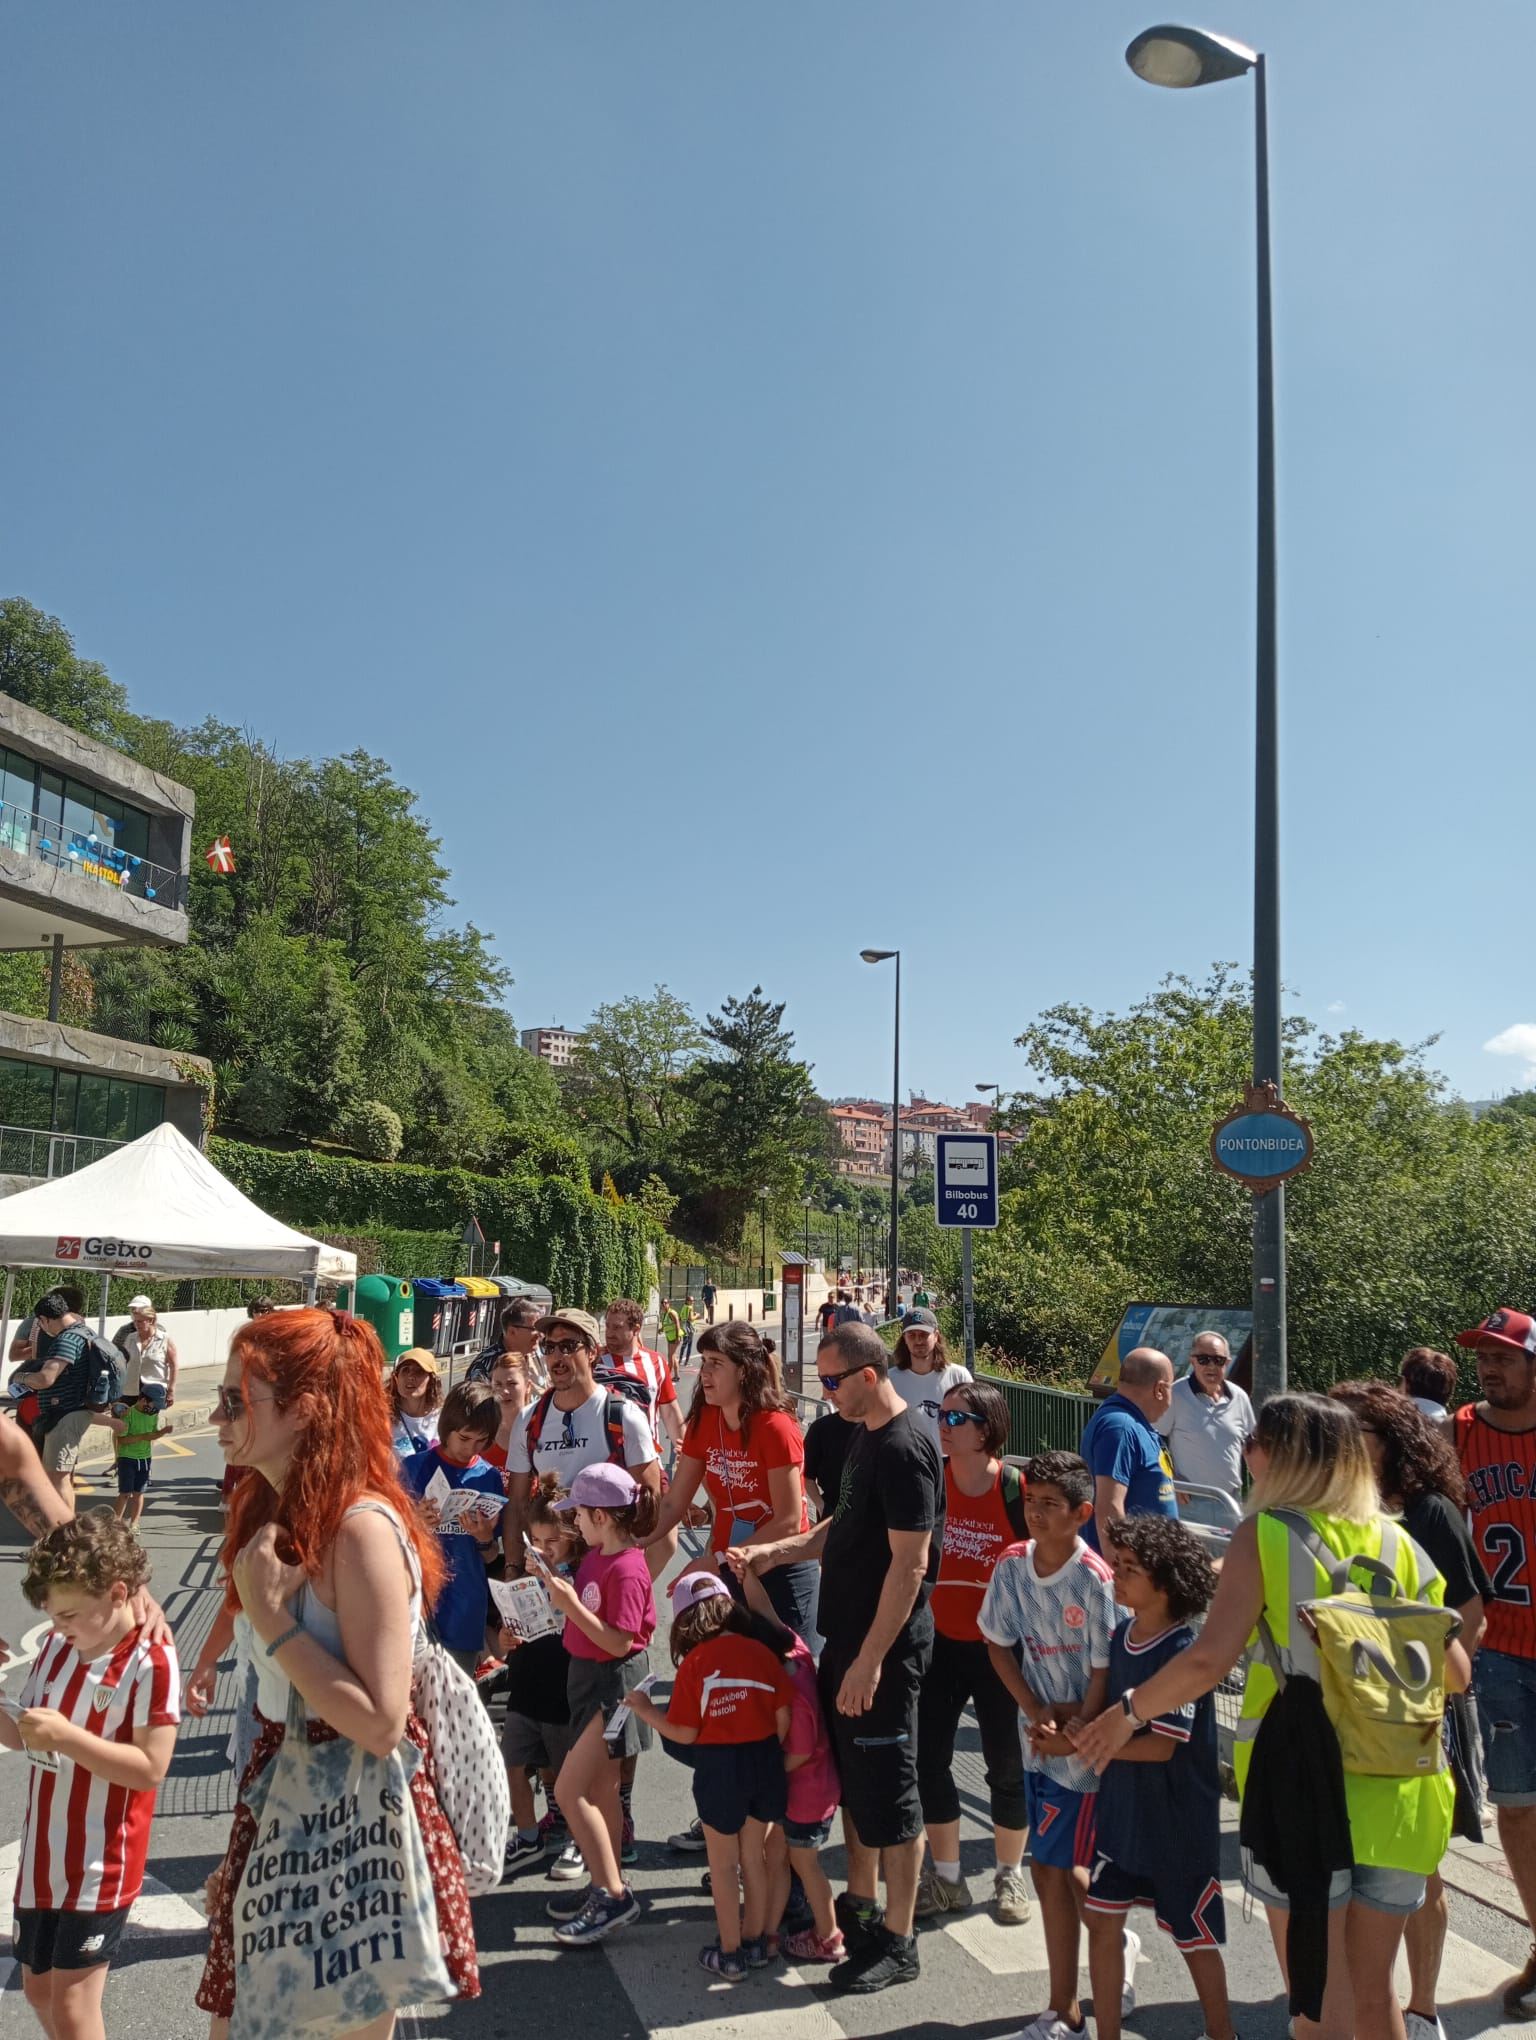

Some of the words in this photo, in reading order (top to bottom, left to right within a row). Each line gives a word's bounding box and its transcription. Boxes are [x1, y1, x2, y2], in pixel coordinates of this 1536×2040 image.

[1220, 1138, 1304, 1151] PONTONBIDEA
[945, 1190, 989, 1200] Bilbobus
[957, 1203, 978, 1219] 40
[84, 1237, 153, 1259] Getxo
[544, 1438, 589, 1451] ZTZKT
[252, 1816, 280, 1851] La
[300, 1793, 359, 1837] vida
[379, 1788, 404, 1816] es
[1037, 1802, 1061, 1836] 7
[246, 1815, 403, 1889] demasiado
[242, 1881, 320, 1923] corta
[329, 1857, 405, 1900] como
[241, 1919, 314, 1965] para
[320, 1887, 407, 1941] estar
[313, 1919, 406, 1990] larri
